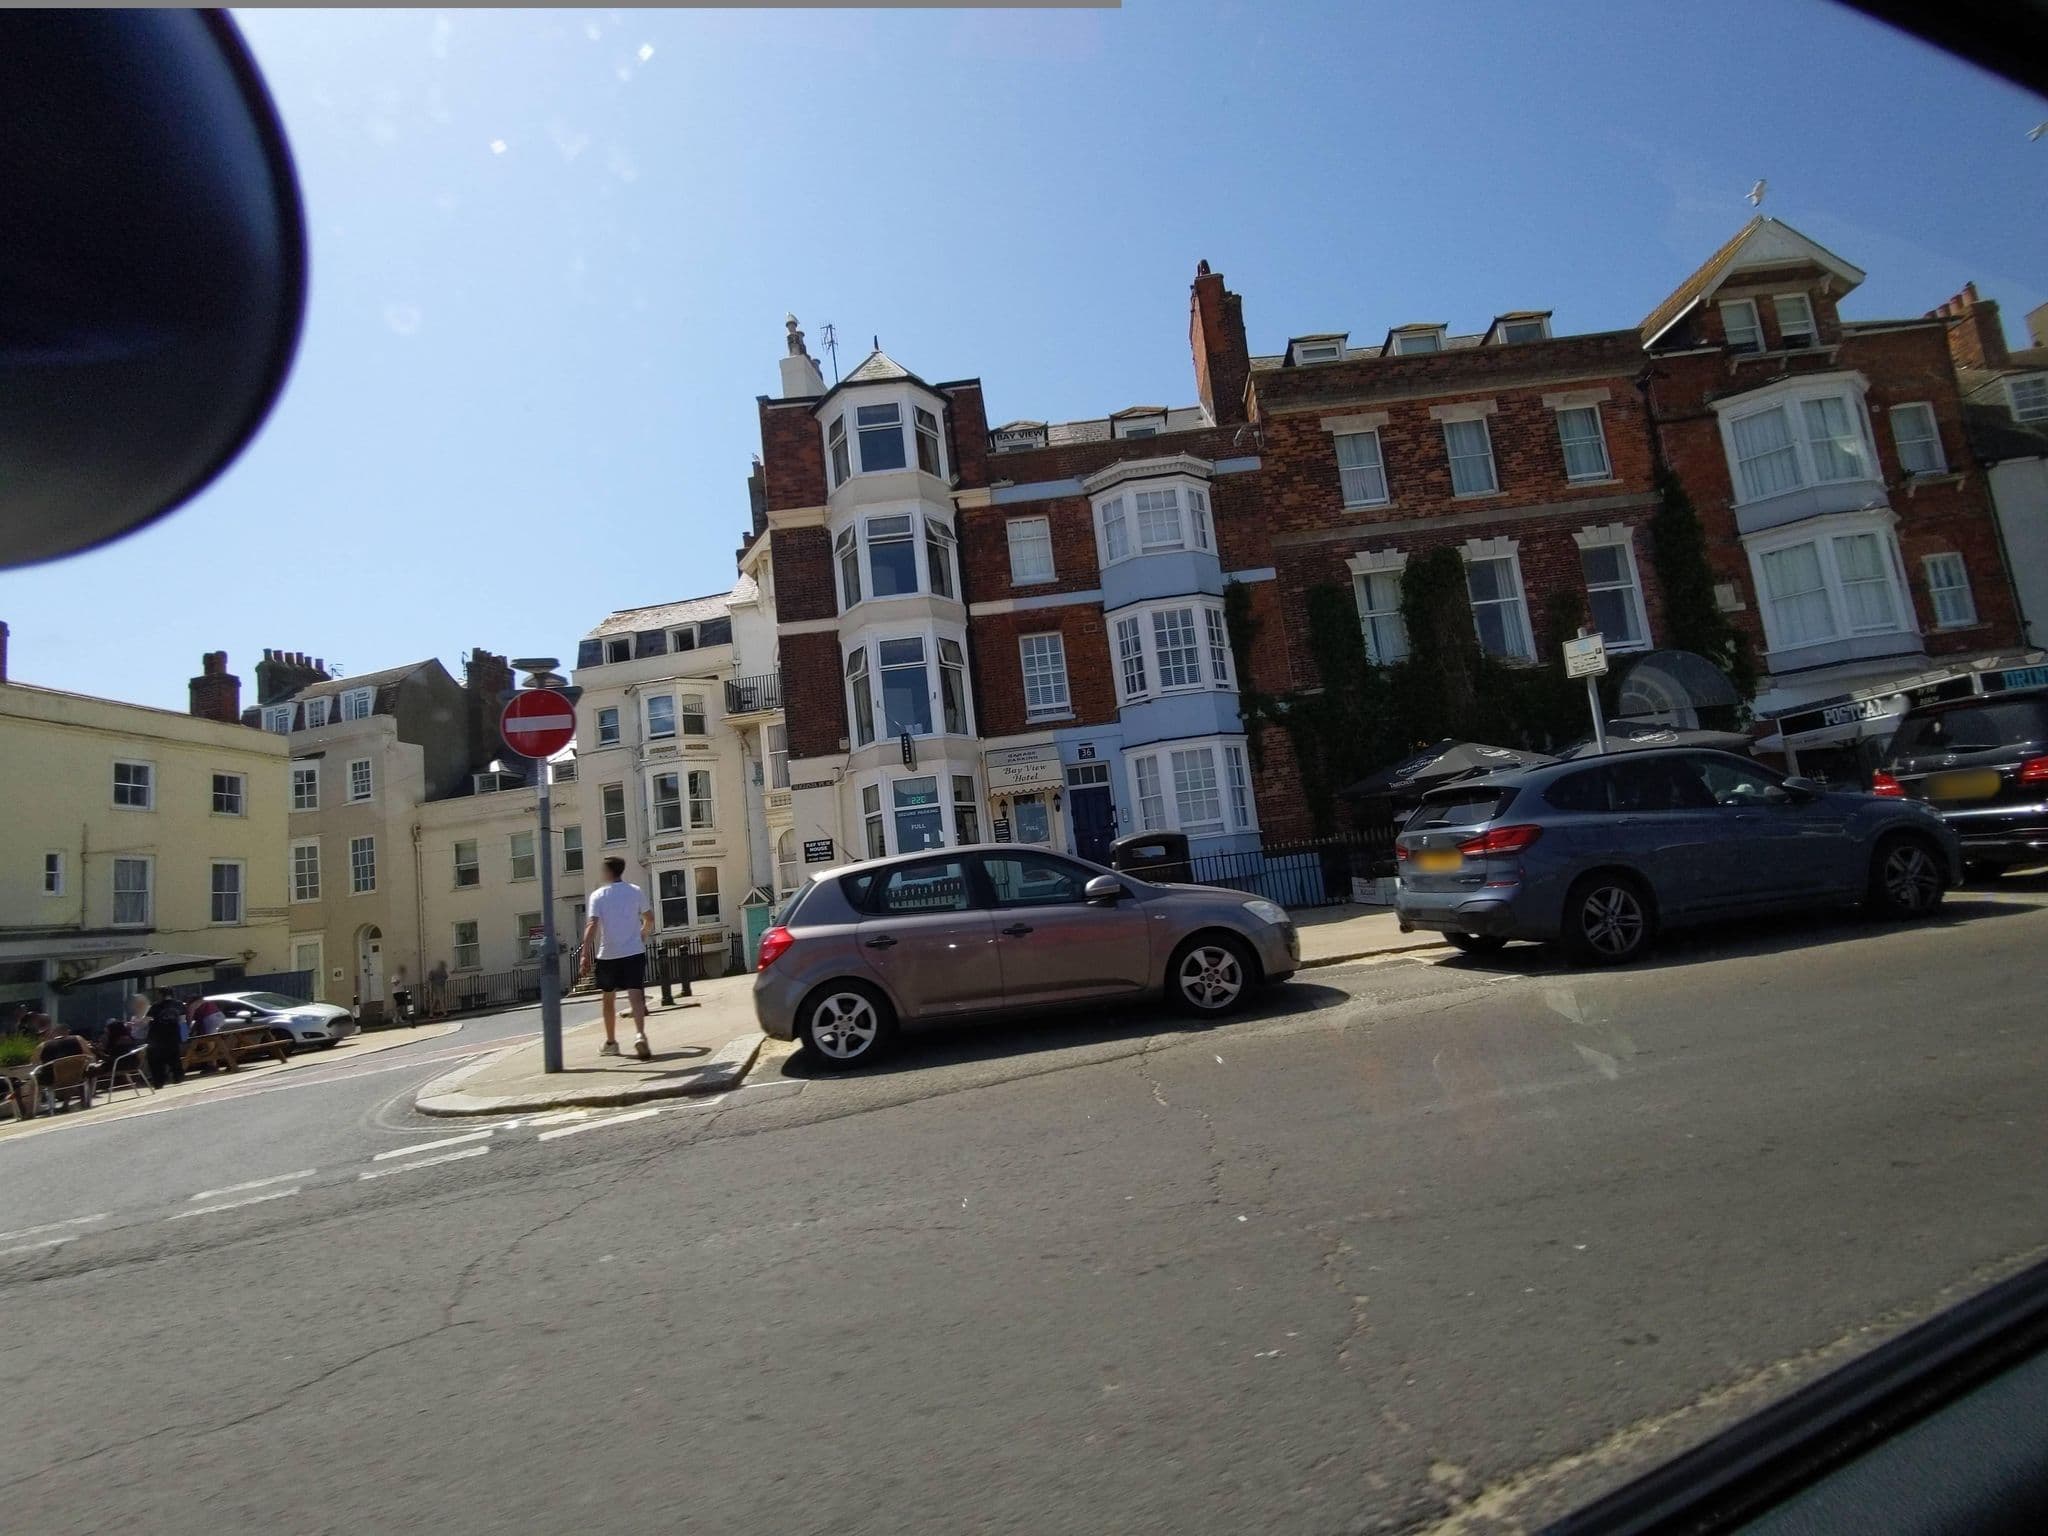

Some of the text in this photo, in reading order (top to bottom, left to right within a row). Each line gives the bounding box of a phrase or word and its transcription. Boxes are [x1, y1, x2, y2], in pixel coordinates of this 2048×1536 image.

[1081, 748, 1092, 757] 36
[1003, 764, 1047, 777] Bay View
[1013, 772, 1038, 783] Hotel
